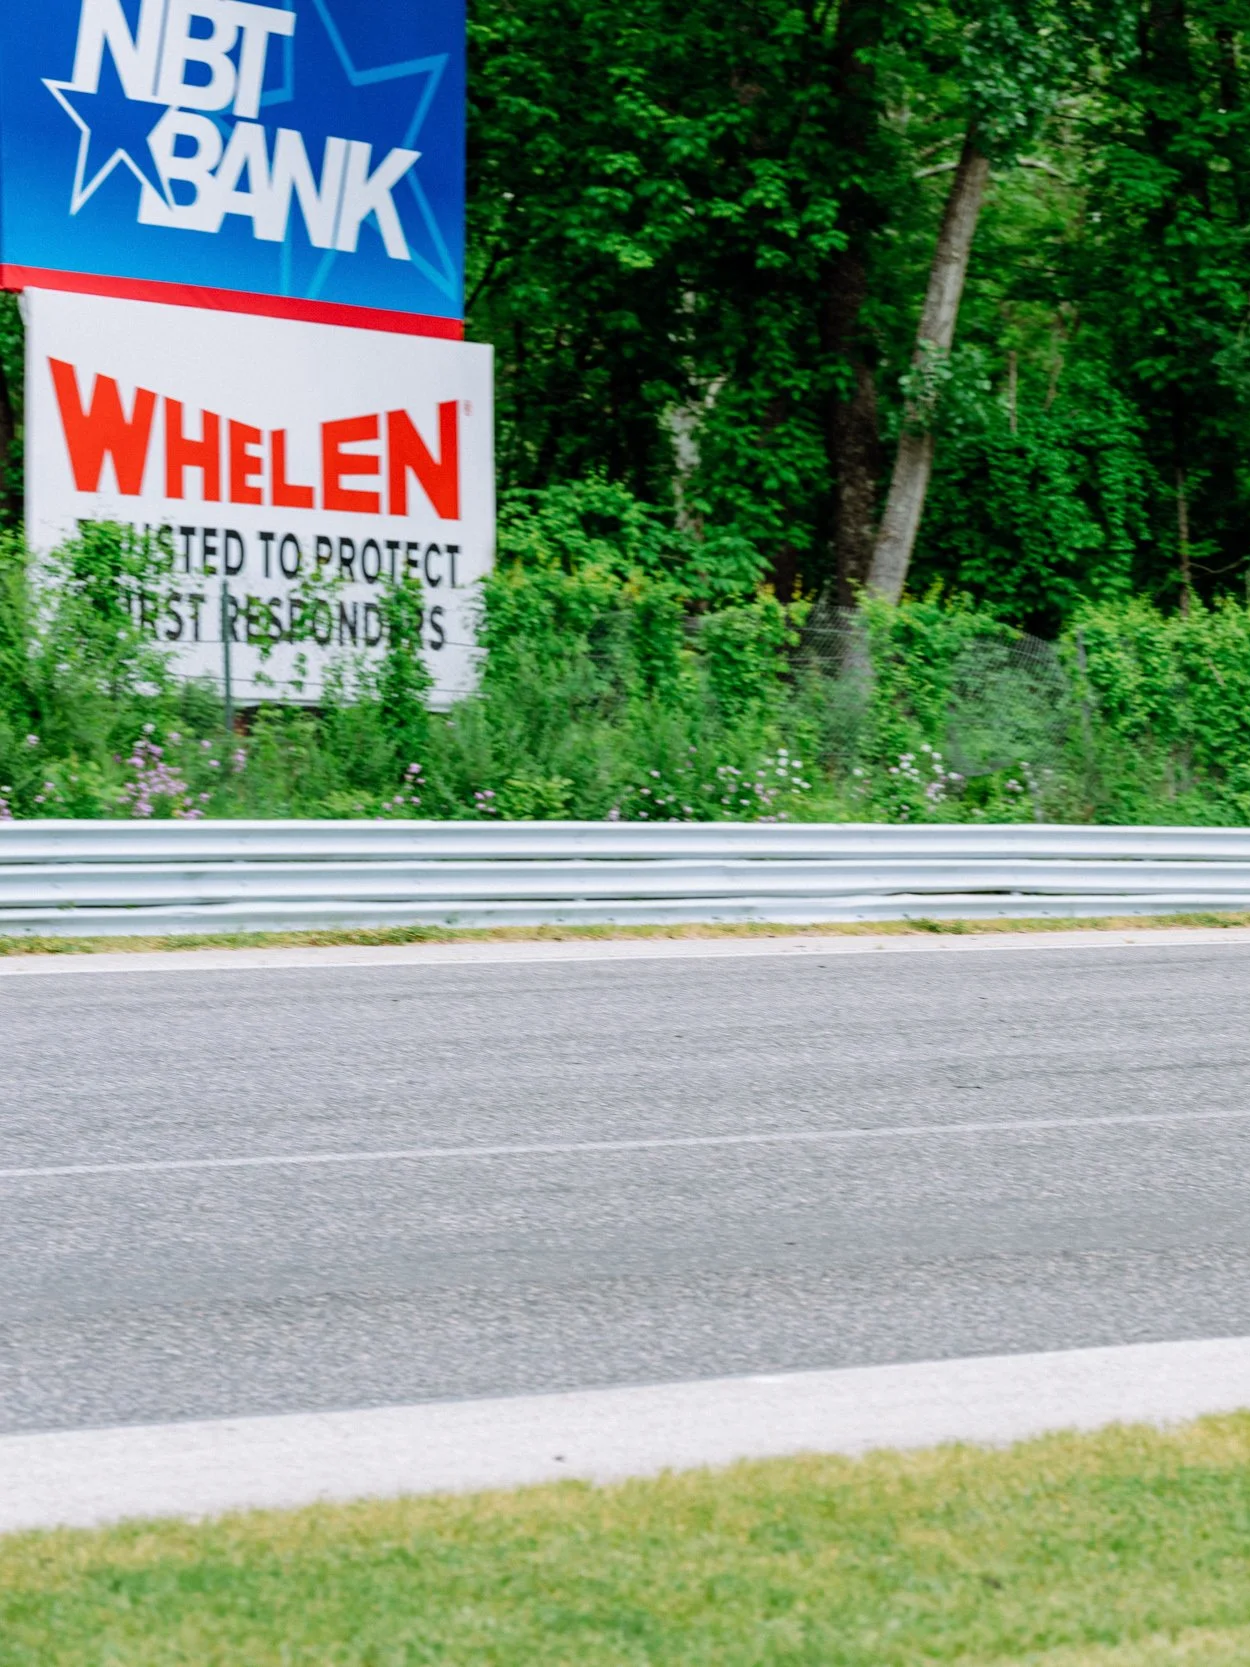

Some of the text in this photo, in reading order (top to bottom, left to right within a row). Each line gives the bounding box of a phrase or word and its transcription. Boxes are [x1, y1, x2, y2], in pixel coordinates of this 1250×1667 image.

[71, 0, 296, 119] NBT
[137, 107, 422, 261] BANK
[46, 355, 463, 521] WHELEN
[258, 531, 302, 579] TO
[315, 535, 463, 589] PROTECT
